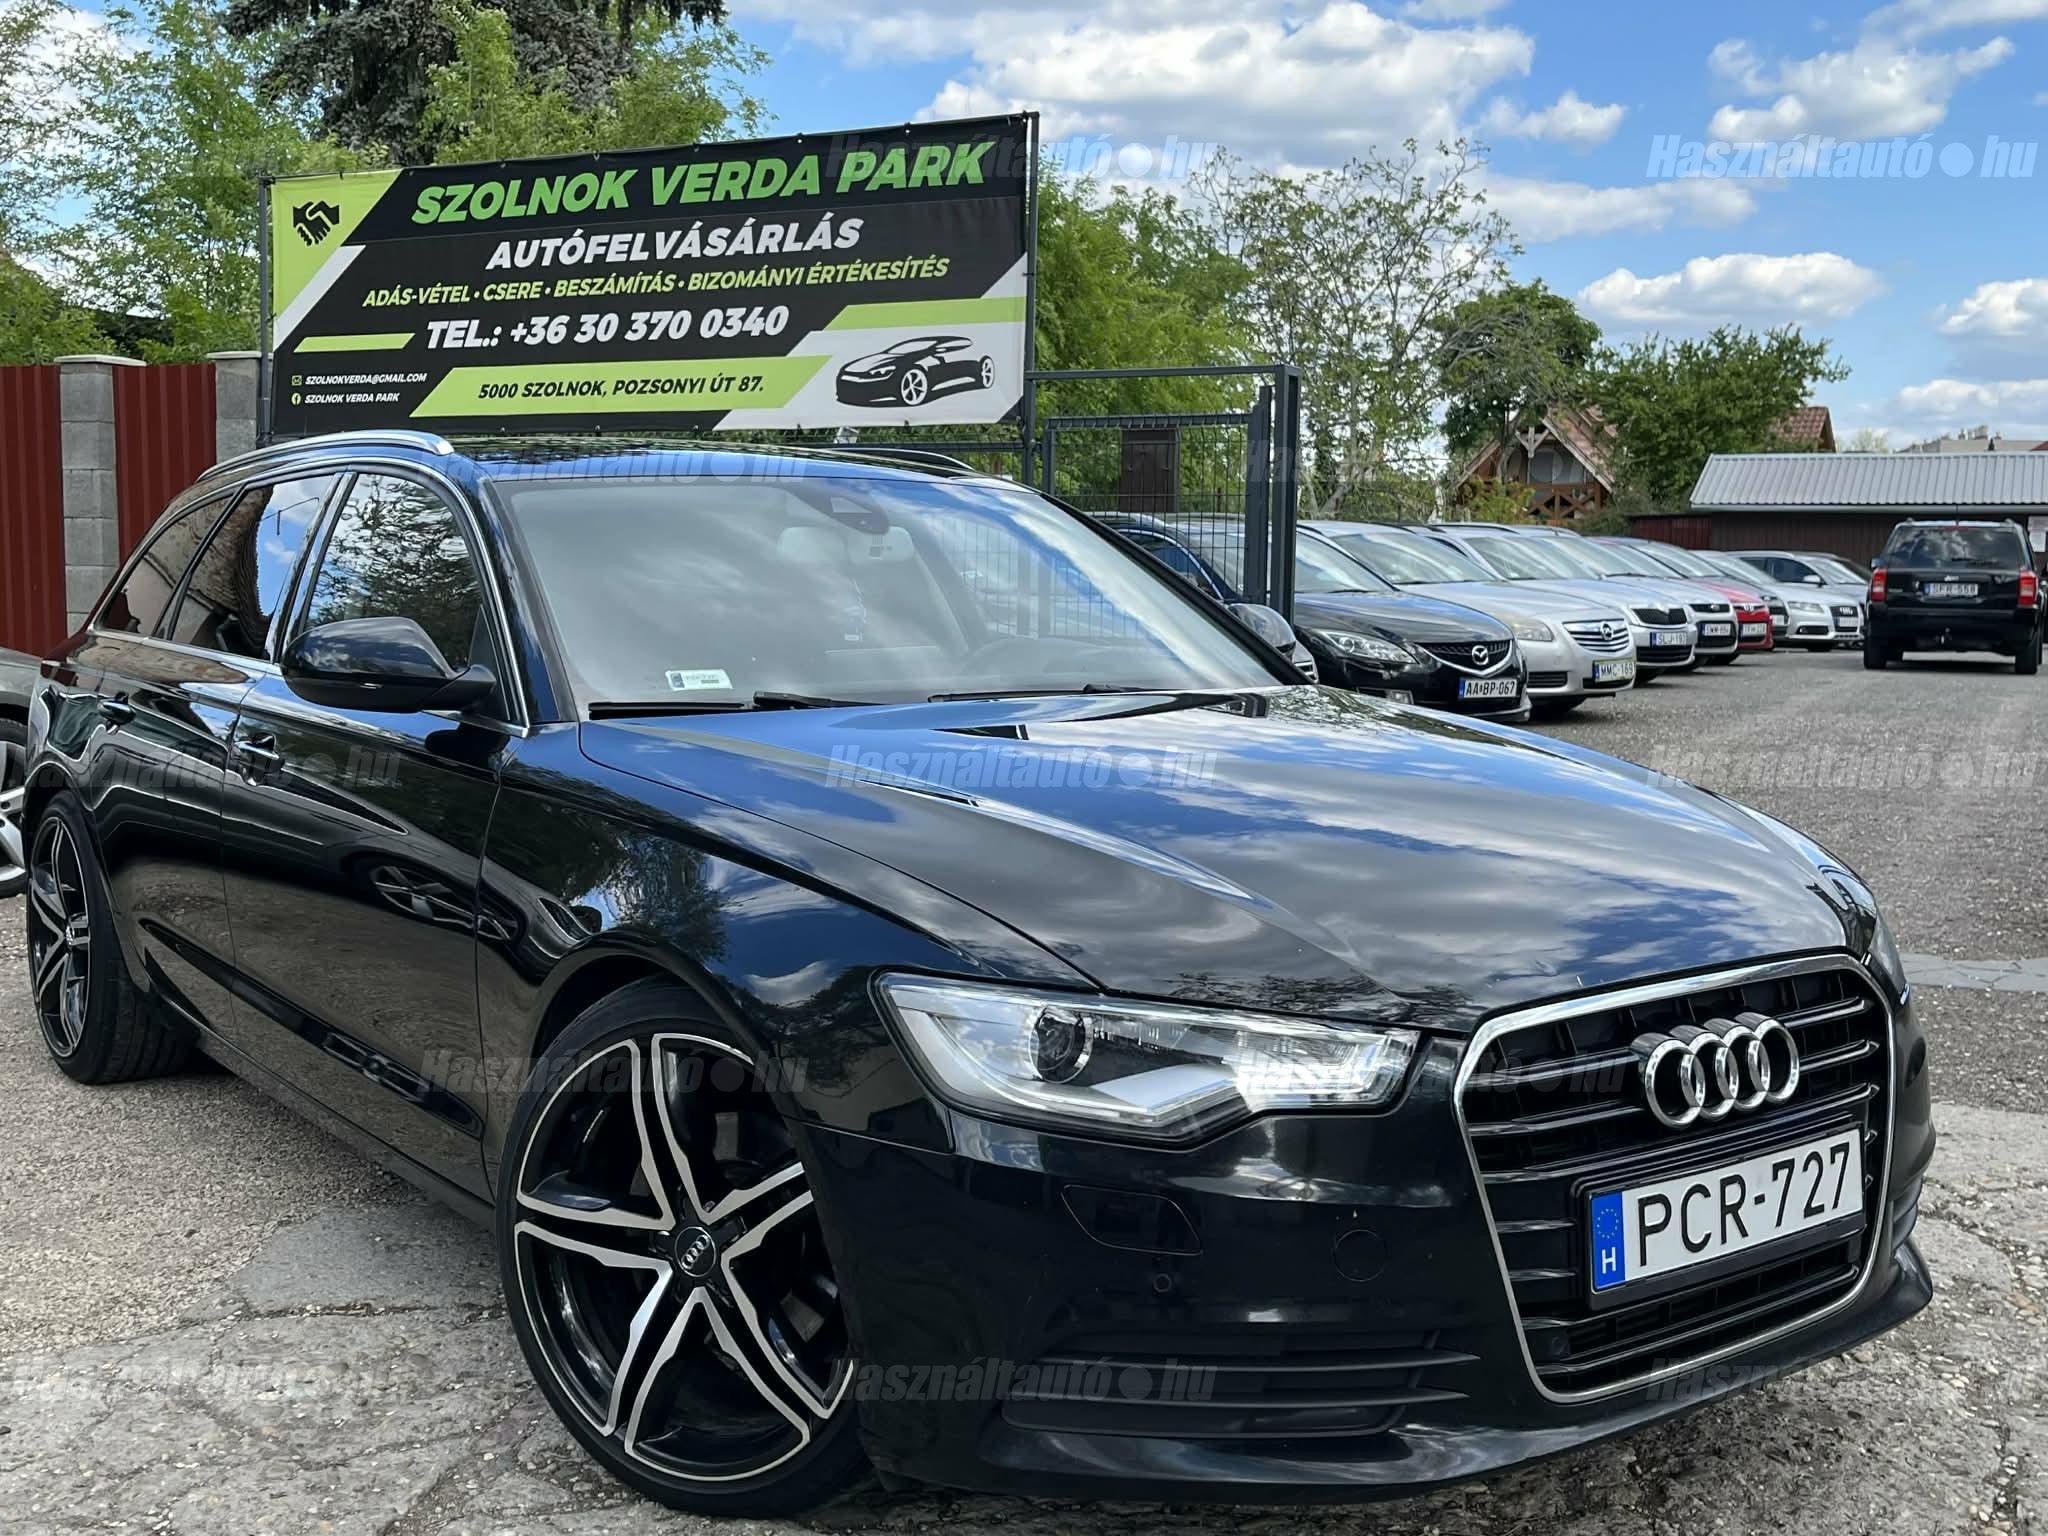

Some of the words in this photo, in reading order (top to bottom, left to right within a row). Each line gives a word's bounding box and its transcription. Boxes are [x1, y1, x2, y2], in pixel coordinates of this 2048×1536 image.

[411, 169, 638, 224] SZOLNOK
[652, 155, 820, 205] VERDA
[836, 141, 995, 193] PARK
[362, 283, 471, 308] ADÁS-VÉTEL
[483, 281, 544, 301] CSERE
[553, 271, 676, 298] BESZÁMÍTÁS
[687, 265, 804, 291] BIZOMÁNYI
[806, 255, 950, 285] ÉRTÉKESÍTÉS
[427, 319, 501, 349] TEL.:
[510, 314, 570, 345] +36
[573, 312, 619, 343] 30
[625, 309, 692, 341] 370
[699, 305, 790, 338] 0340
[304, 372, 428, 385] SZOLNOKVERDA@GMAIL.COM
[478, 383, 518, 399] 5000
[521, 380, 606, 398] SZOLNOK,
[612, 377, 704, 396] POZSONYI
[709, 372, 736, 393] ÚT
[738, 375, 764, 392] 87.
[304, 393, 345, 404] SZOLNOK
[345, 392, 374, 403] VERDA
[375, 392, 401, 402] PARK
[1637, 1142, 1850, 1267] PCR-727
[1601, 1247, 1616, 1274] H
